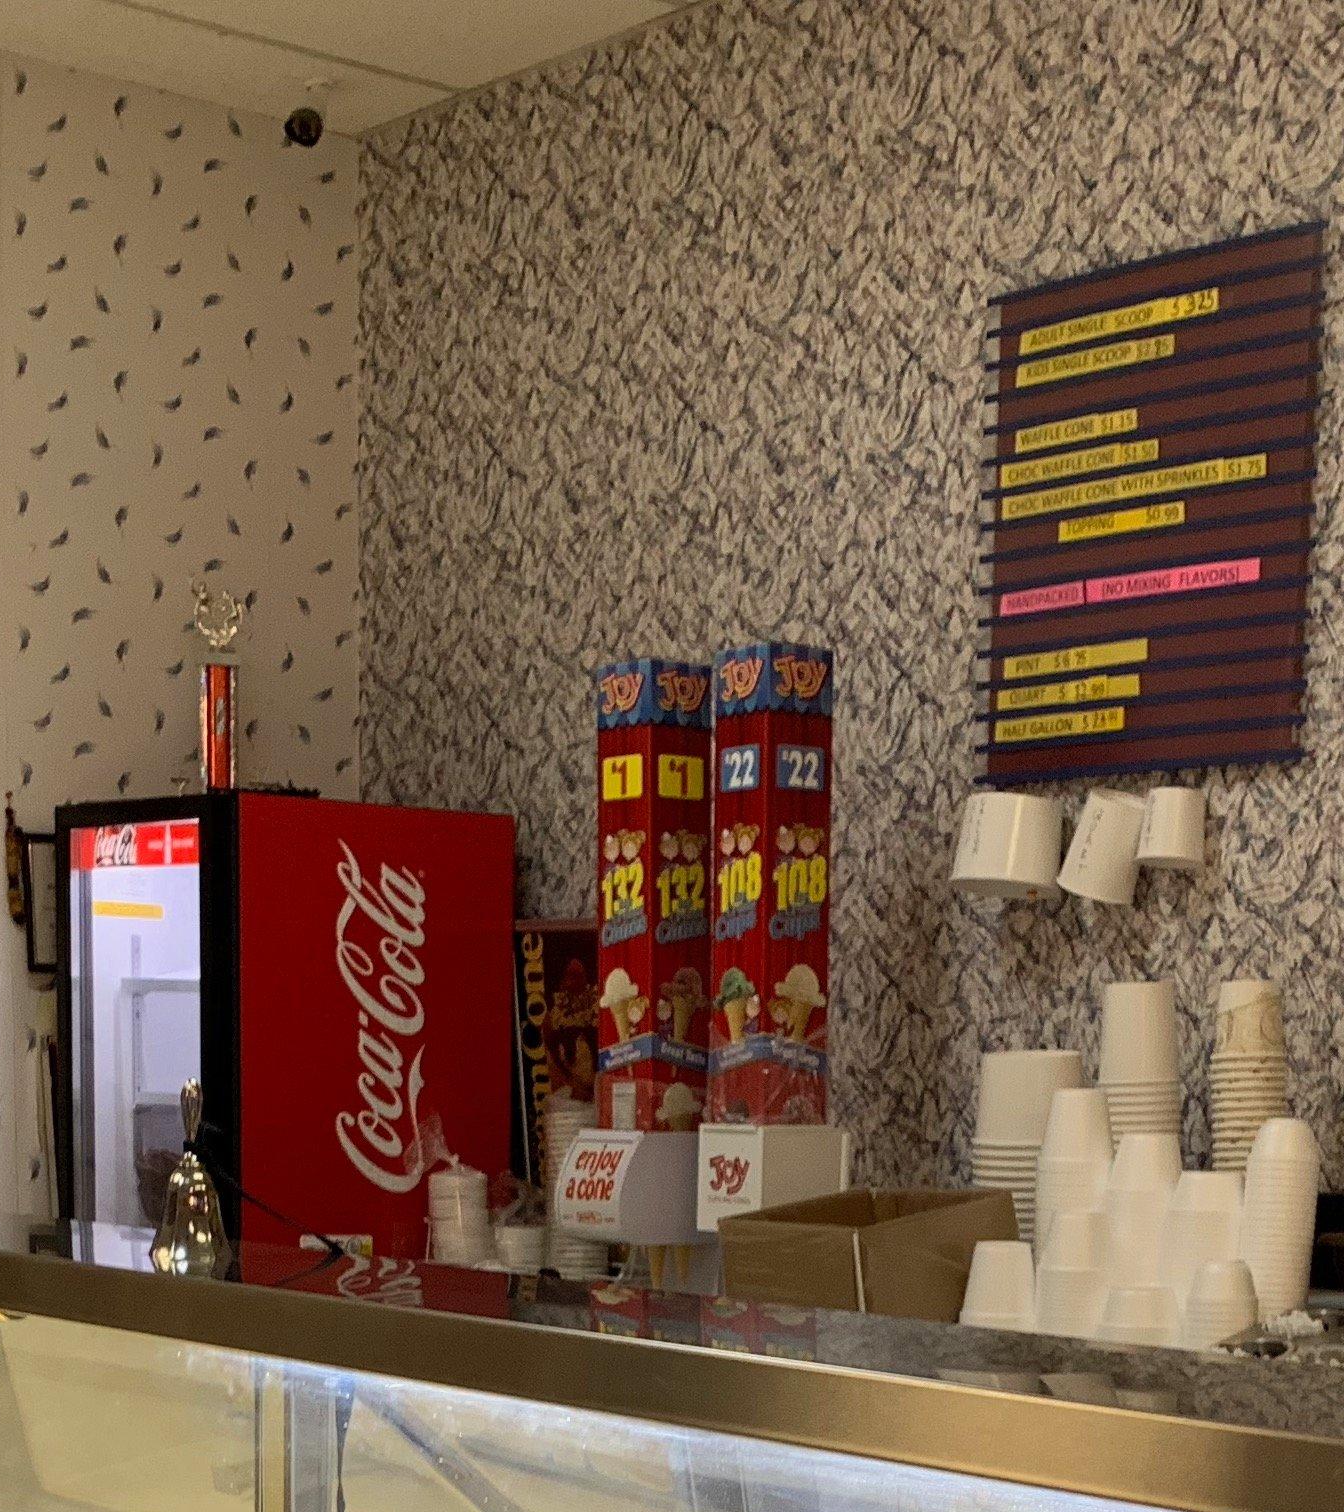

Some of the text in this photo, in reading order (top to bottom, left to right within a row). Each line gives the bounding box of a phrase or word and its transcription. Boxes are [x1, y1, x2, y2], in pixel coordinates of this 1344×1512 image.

[1029, 307, 1154, 348] ADULT SINGLE SCOOP
[1053, 344, 1131, 374] SINGLE SCOOP
[1020, 422, 1061, 447] WAFFLE
[1064, 417, 1094, 439] CONE
[1007, 462, 1038, 482] CHOC
[1041, 455, 1082, 476] WAFFLE
[1085, 450, 1115, 468] CONE
[1007, 495, 1038, 515] CHOC
[1041, 486, 1083, 508] WAFFLE
[1085, 481, 1117, 501] CONE
[1119, 474, 1155, 493] WITH
[1155, 463, 1219, 488] SPRINKLES
[1066, 514, 1116, 536] TOPPING
[1126, 574, 1172, 595] MIXING
[1015, 659, 1039, 674] PINT
[1009, 688, 1047, 705] QUART
[1029, 716, 1074, 736] GALLON
[718, 851, 762, 914] 108
[772, 853, 828, 912] 108
[575, 1144, 624, 1178] enjoy
[565, 1176, 615, 1201] a cone
